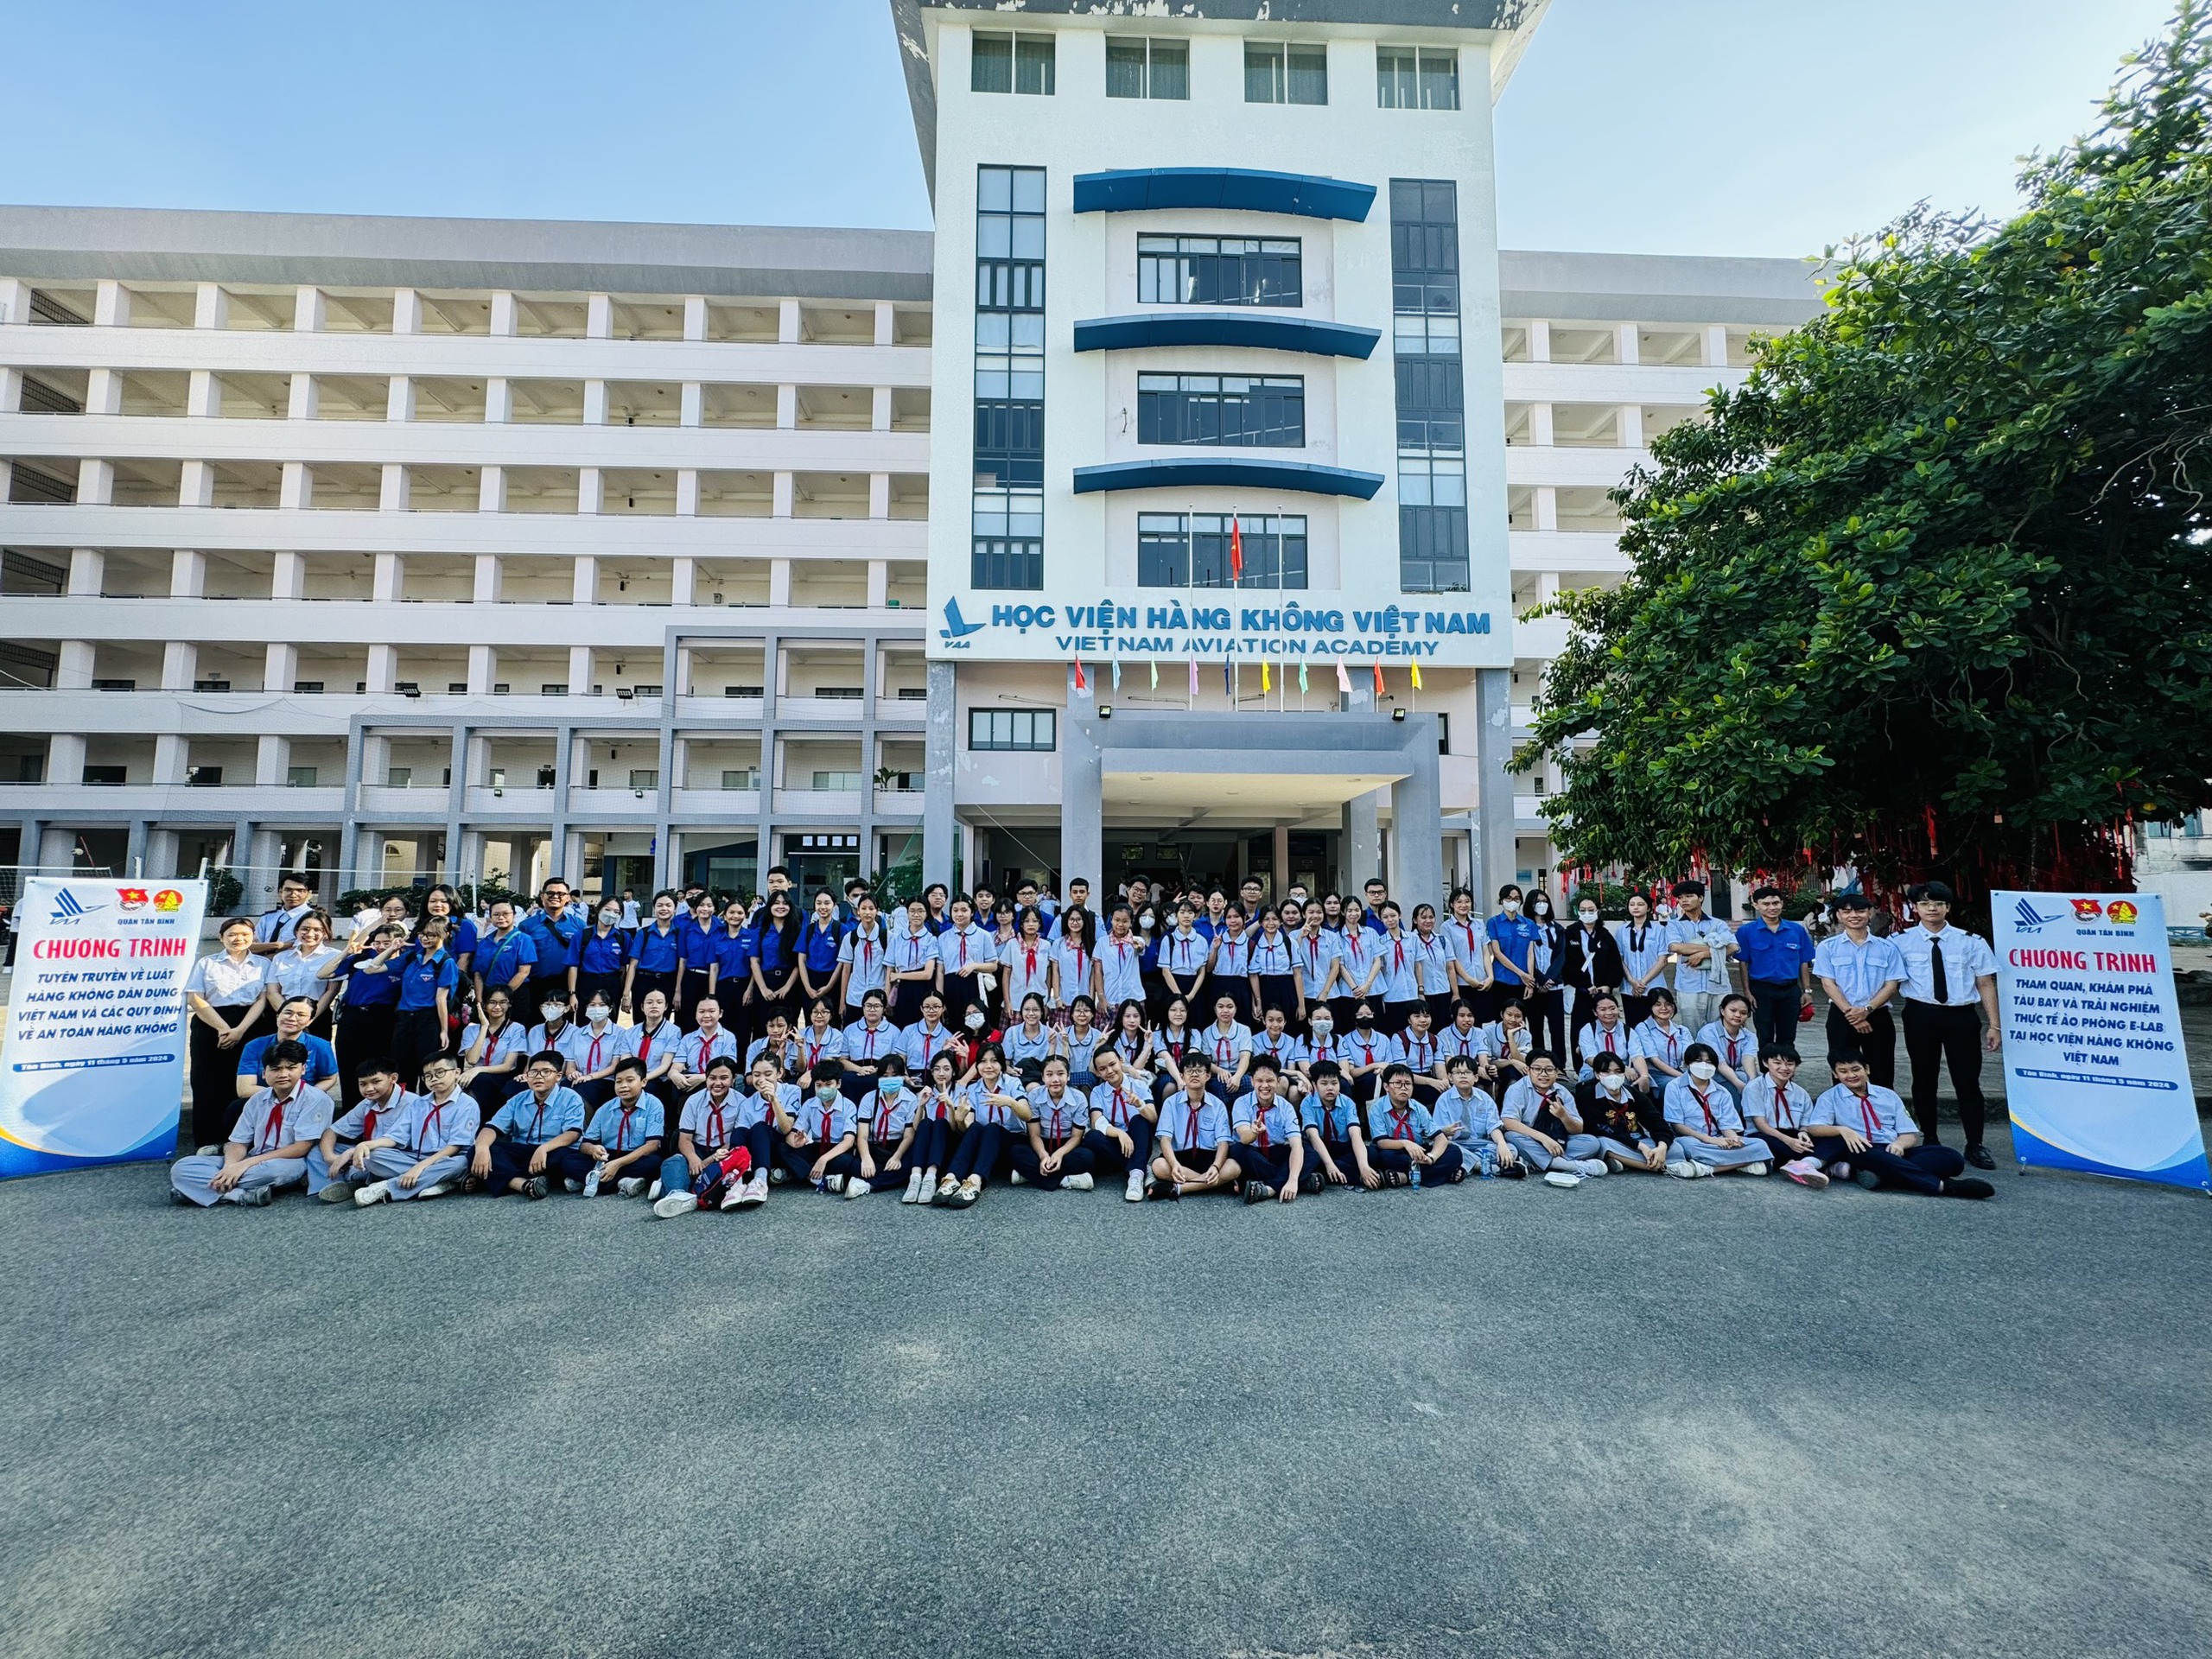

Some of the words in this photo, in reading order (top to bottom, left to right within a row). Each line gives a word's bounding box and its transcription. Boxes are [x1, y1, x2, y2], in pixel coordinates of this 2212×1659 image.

[992, 604, 1056, 634] HỌC
[1065, 599, 1137, 635] VIỆN
[1147, 599, 1230, 630] HÀNG
[1240, 601, 1344, 632] KHÔNG
[1352, 605, 1420, 639] VIỆT
[1425, 612, 1491, 634] NAM
[944, 640, 970, 649] VAA
[1181, 638, 1306, 654] AVIATION
[1313, 639, 1439, 655] ACADEMY
[33, 938, 121, 959] CHƯƠNG
[129, 935, 187, 957] TRÌNH
[2009, 948, 2088, 970] CHƯƠNG
[2093, 950, 2157, 973] TRÌNH
[37, 970, 79, 983] TUYÊN
[81, 967, 128, 982] TRUYỀN
[130, 966, 145, 981] VỀ
[146, 968, 175, 982] LUẬT
[26, 989, 66, 1002] HÀNG
[68, 987, 115, 1001] KHÔNG
[117, 987, 143, 1000] DÂN
[144, 988, 179, 1001] DỤNG
[2016, 979, 2047, 989] THAM
[2050, 981, 2086, 994] QUAN,
[2088, 981, 2125, 994] KHÁM
[2127, 982, 2154, 995] PHÁ
[18, 1008, 47, 1024] VIỆT
[48, 1009, 79, 1020] NAM
[81, 1006, 98, 1019] VÀ
[101, 1005, 124, 1018] CÁC
[126, 1006, 152, 1017] QUY
[153, 1005, 182, 1018] ĐỊNH
[2013, 995, 2035, 1006] TÀU
[2037, 997, 2060, 1007] BAY
[2063, 996, 2078, 1008] VÀ
[2110, 1001, 2160, 1016] NGHIỆM
[18, 1026, 35, 1040] VỀ
[36, 1028, 57, 1039] AN
[60, 1025, 94, 1038] TOÀN
[96, 1023, 132, 1036] HÀNG
[134, 1021, 178, 1034] KHÔNG
[2014, 1012, 2044, 1027] THỰC
[2045, 1011, 2058, 1025] TẾ
[2082, 1017, 2126, 1031] PHÒNG
[2129, 1020, 2164, 1033] E-LAB
[2009, 1030, 2027, 1043] TẠI
[2029, 1032, 2054, 1045] HỌC
[2056, 1032, 2084, 1047] VIỆN
[2087, 1033, 2123, 1048] HÀNG
[2126, 1038, 2175, 1052] KHÔNG
[2063, 1050, 2088, 1066] VIỆT
[2091, 1054, 2120, 1065] NAM
